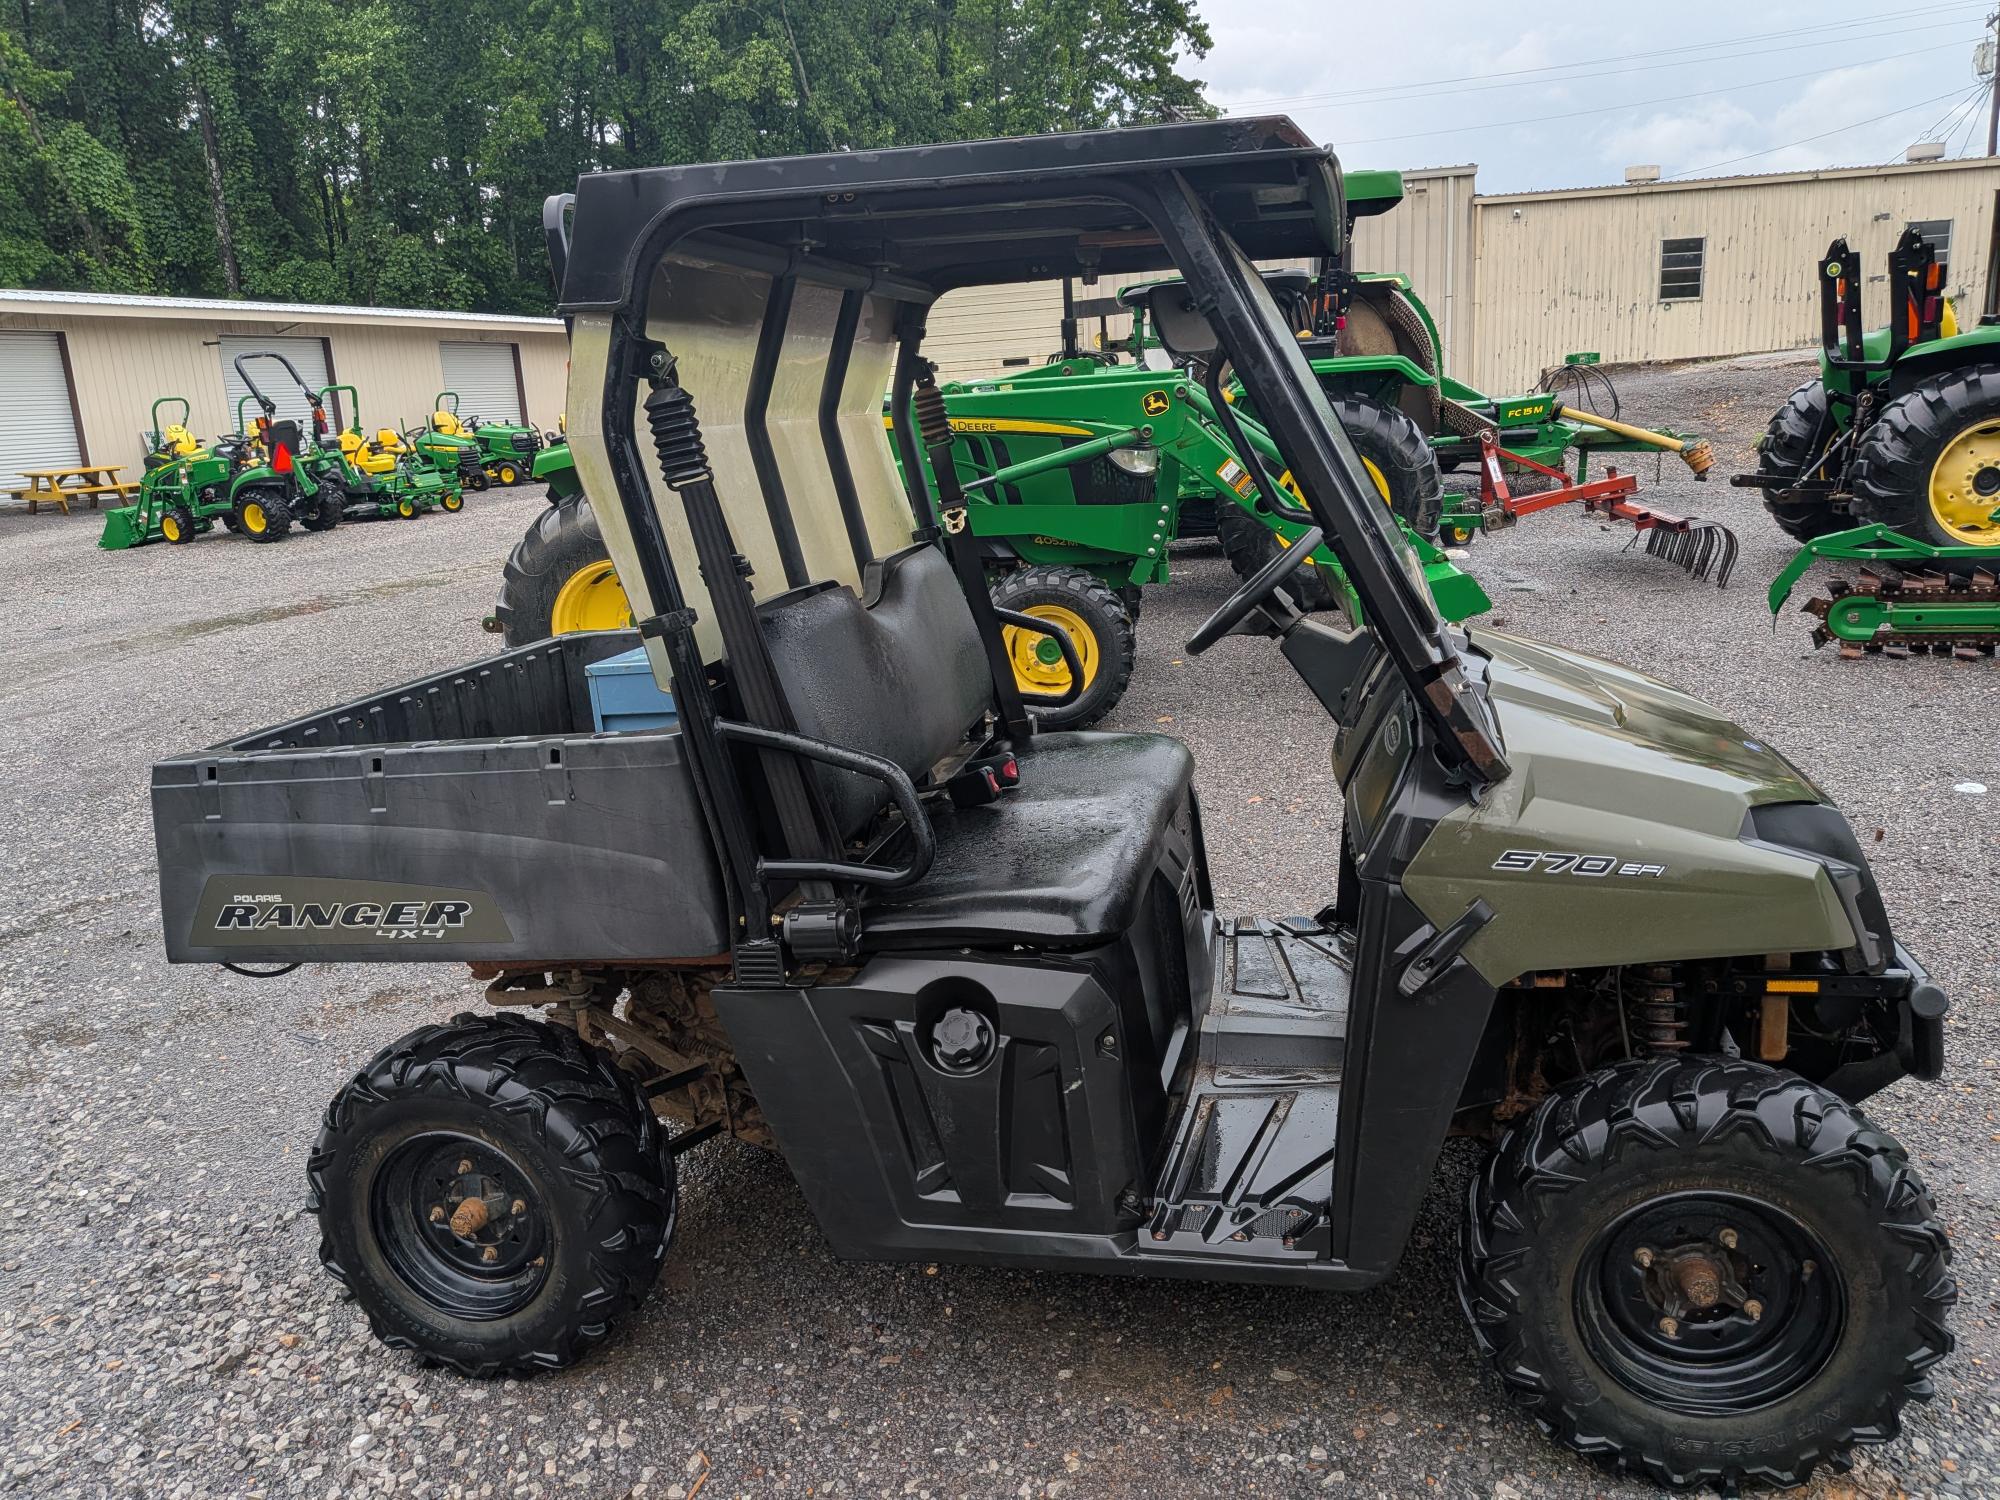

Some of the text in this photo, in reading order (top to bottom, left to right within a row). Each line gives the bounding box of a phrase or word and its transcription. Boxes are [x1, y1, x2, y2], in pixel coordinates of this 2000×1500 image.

[1508, 405, 1544, 418] FC 15 M
[957, 421, 997, 431] DEERE
[1491, 850, 1668, 878] 570 EFI
[233, 894, 282, 903] POLARIS
[214, 901, 474, 930] RANGER
